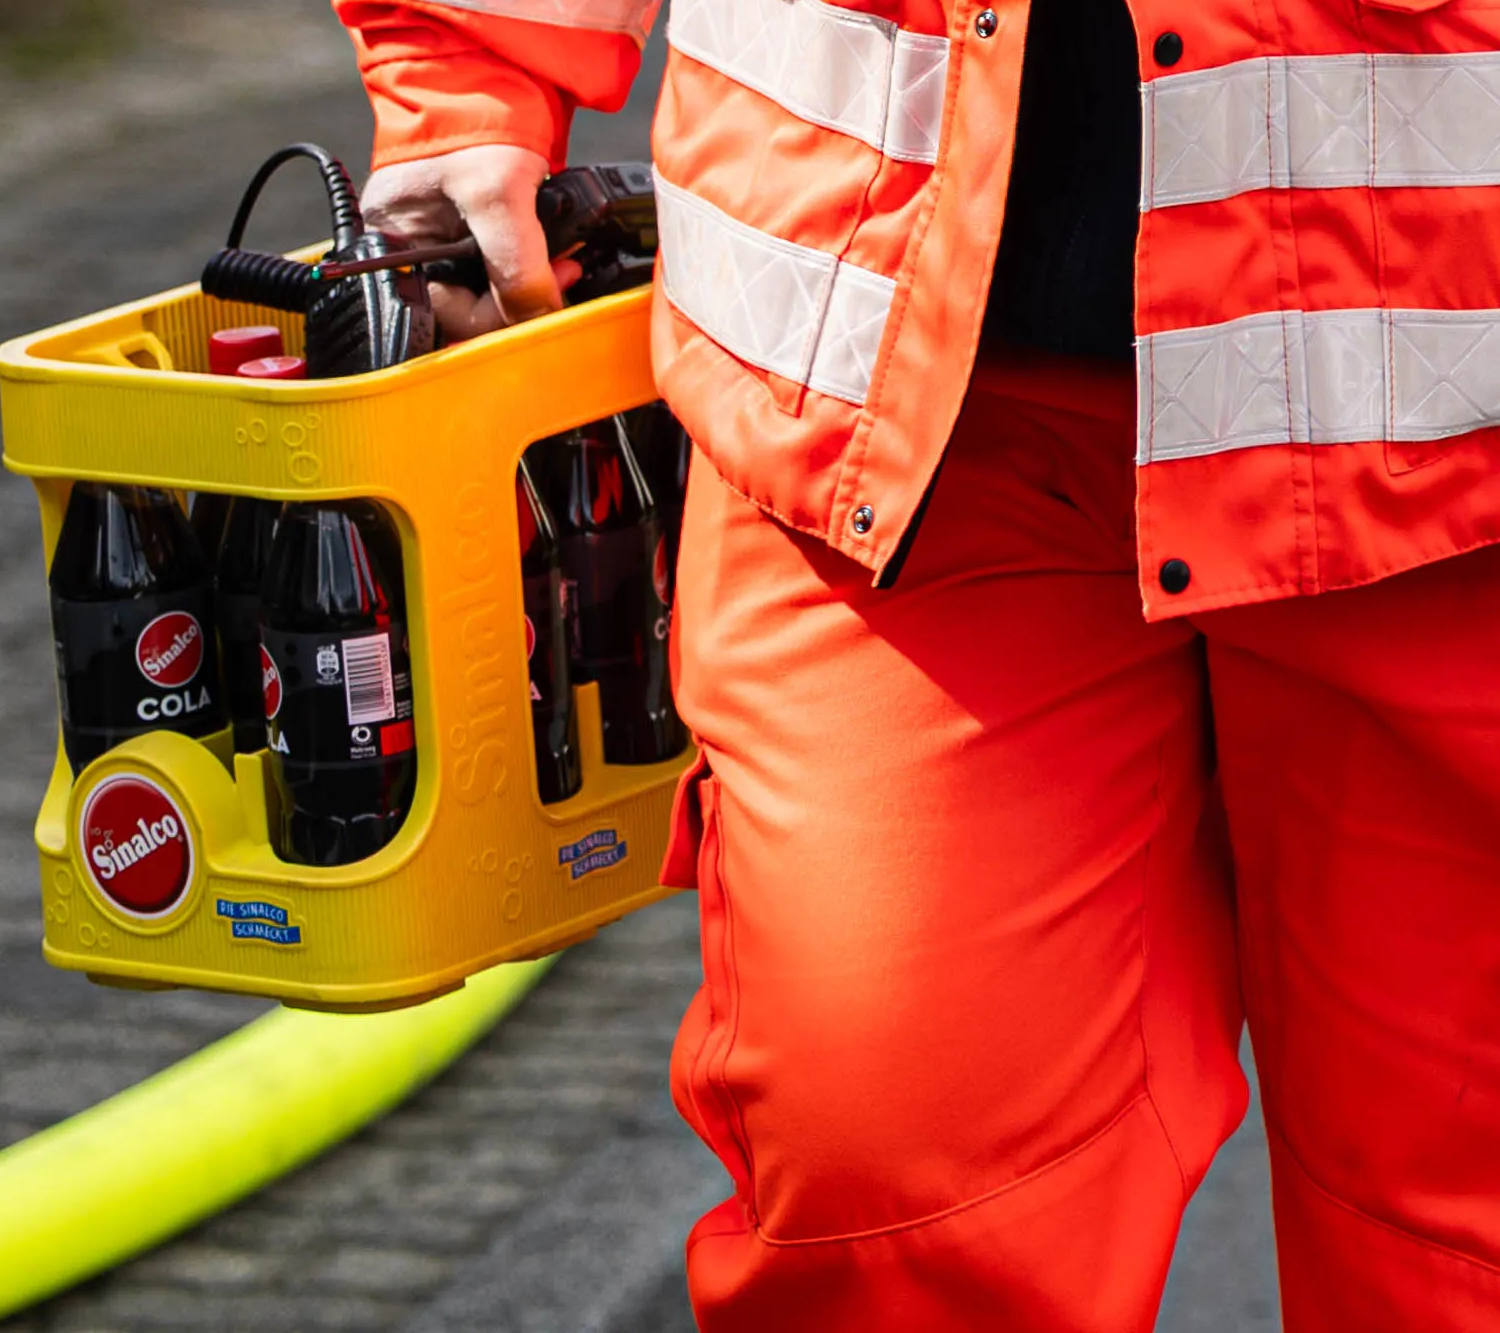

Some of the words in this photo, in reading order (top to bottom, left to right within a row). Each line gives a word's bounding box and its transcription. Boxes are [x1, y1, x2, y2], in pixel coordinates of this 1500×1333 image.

[142, 624, 198, 677] Sinalco
[137, 685, 211, 721] COLA
[92, 814, 179, 879] Sinalco
[220, 902, 234, 916] DIE
[240, 902, 284, 922] SINALCO
[235, 924, 289, 942] SCHMECKT
